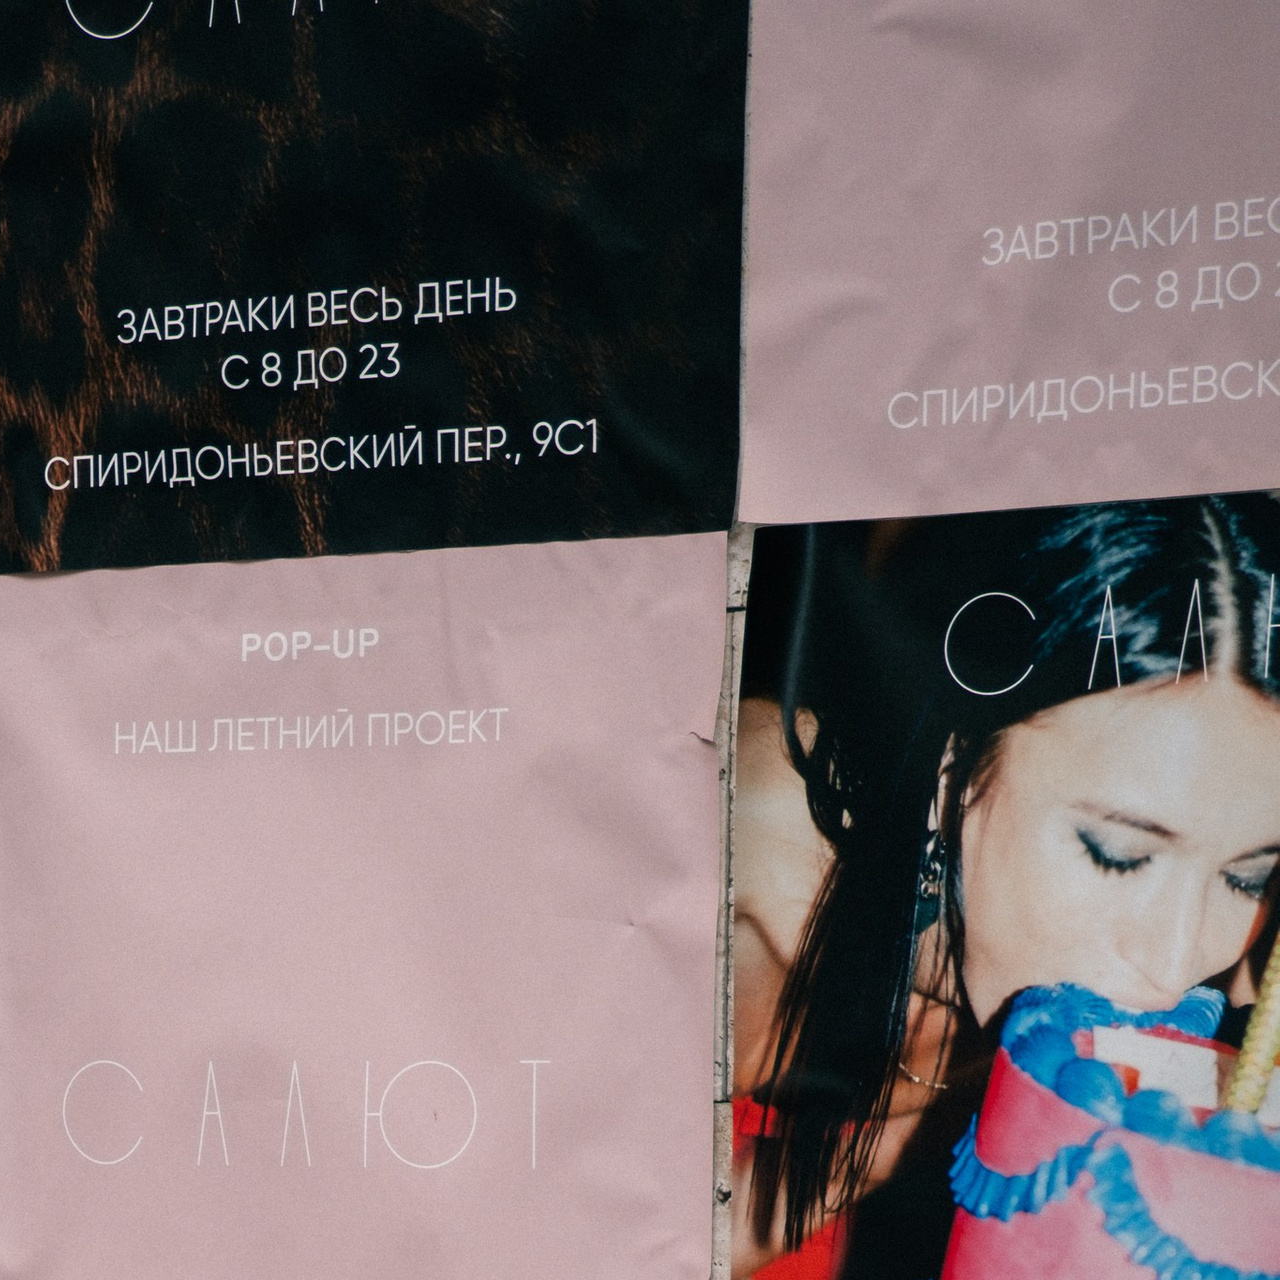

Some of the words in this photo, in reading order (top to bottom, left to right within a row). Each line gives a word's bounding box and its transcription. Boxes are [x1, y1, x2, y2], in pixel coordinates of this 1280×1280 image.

[982, 205, 1198, 265] ЗАВТРАКИ
[118, 295, 294, 343] ЗАВТРАКИ
[308, 287, 402, 327] ВЕСЬ
[414, 277, 516, 324] ДЕНЬ
[1108, 274, 1141, 312] С
[1156, 270, 1178, 308] 8
[1191, 262, 1260, 311] ДО
[221, 355, 249, 389] С
[262, 352, 281, 387] 8
[294, 347, 347, 390] ДО
[360, 343, 400, 379] 23
[888, 359, 1280, 429] СПИРИДОНЬЕВСК
[45, 425, 423, 490] СПИРИДОНЬЕВСКИЙ
[437, 426, 520, 465] ПЕР.,
[533, 419, 597, 456] 9С1
[242, 628, 379, 661] POP-UP
[944, 574, 1280, 695] САЛ
[115, 720, 196, 754] НАШ
[209, 708, 353, 751] ЛЕТНИЙ
[368, 708, 508, 746] ПРОЕКТ
[62, 1060, 551, 1169] САЛЮТ
